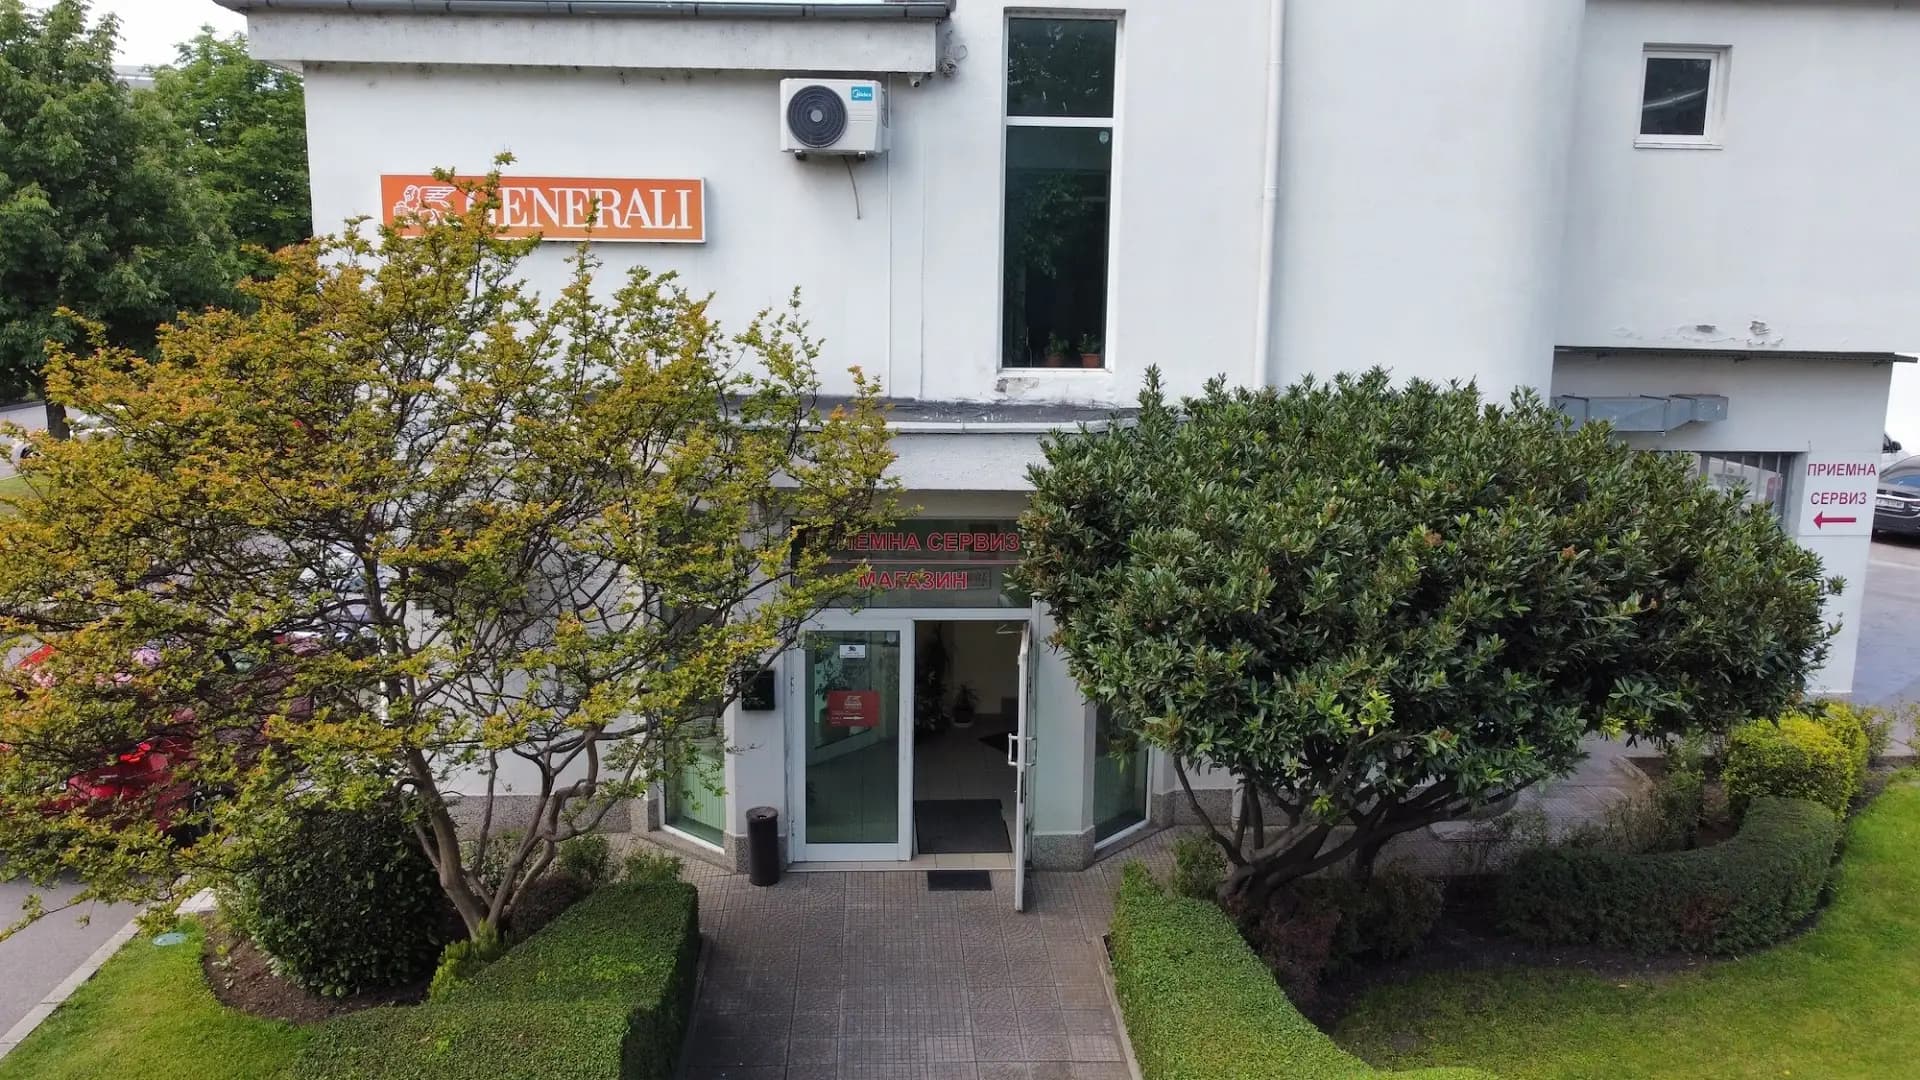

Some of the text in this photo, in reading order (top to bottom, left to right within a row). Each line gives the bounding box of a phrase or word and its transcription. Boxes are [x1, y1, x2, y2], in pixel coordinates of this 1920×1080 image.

[1807, 463, 1877, 476] ПРИЕМНА
[1810, 491, 1867, 505] СЕРВИЗ
[926, 532, 1020, 551] СЕРВИЗ
[858, 570, 968, 590] МАГАЗИН
